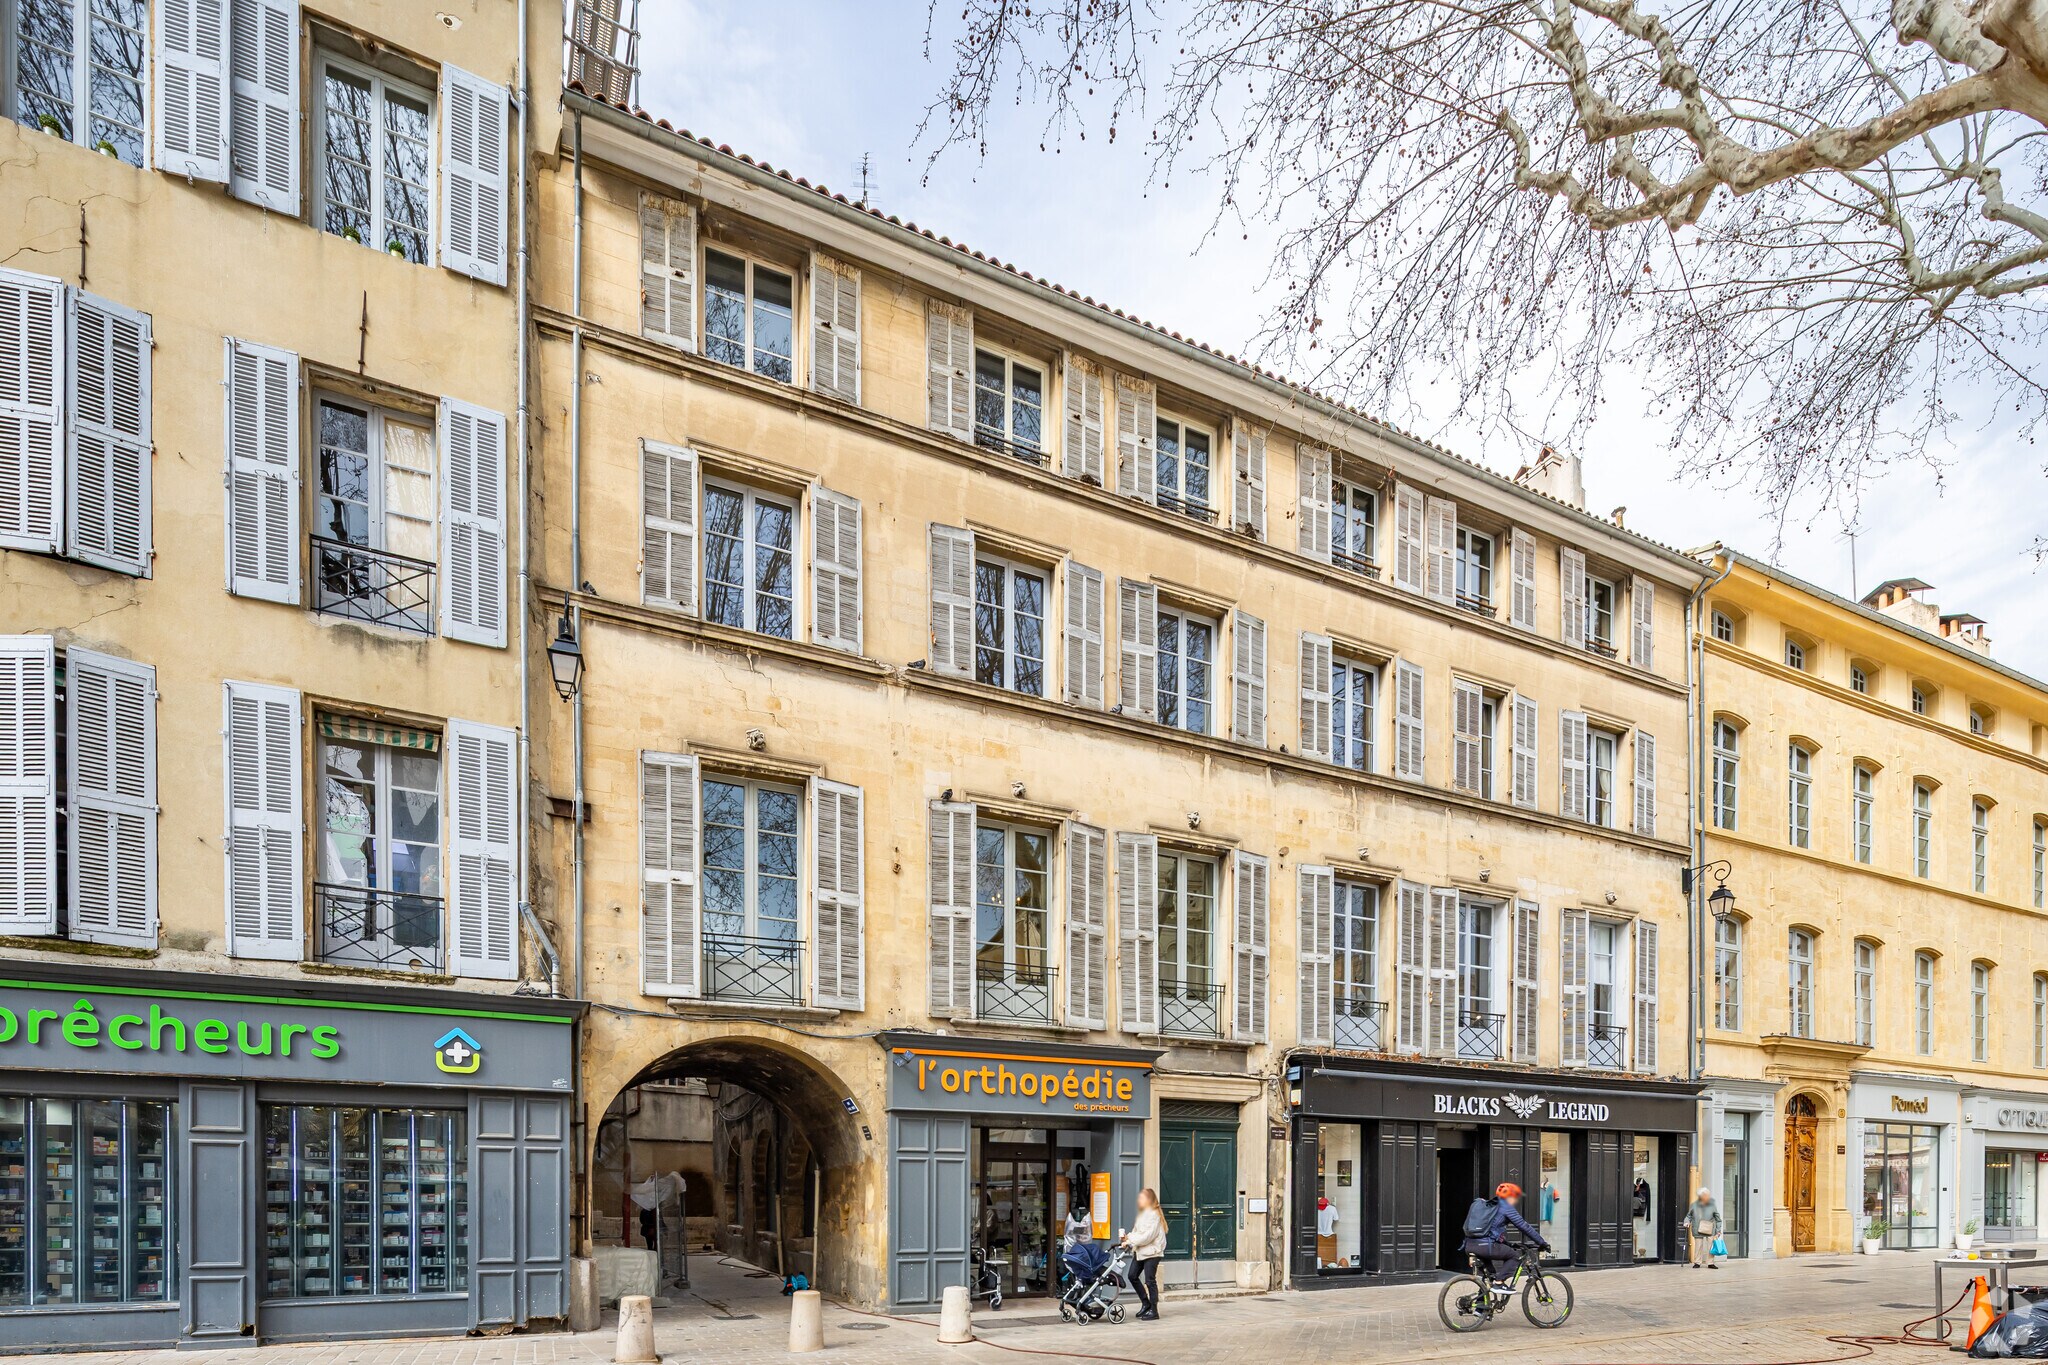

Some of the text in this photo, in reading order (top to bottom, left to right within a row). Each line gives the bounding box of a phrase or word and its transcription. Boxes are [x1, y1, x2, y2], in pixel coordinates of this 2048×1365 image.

[919, 1059, 1133, 1104] l'orthopédie
[1074, 1102, 1088, 1111] des
[1433, 1094, 1610, 1122] BLACKS LEGEND
